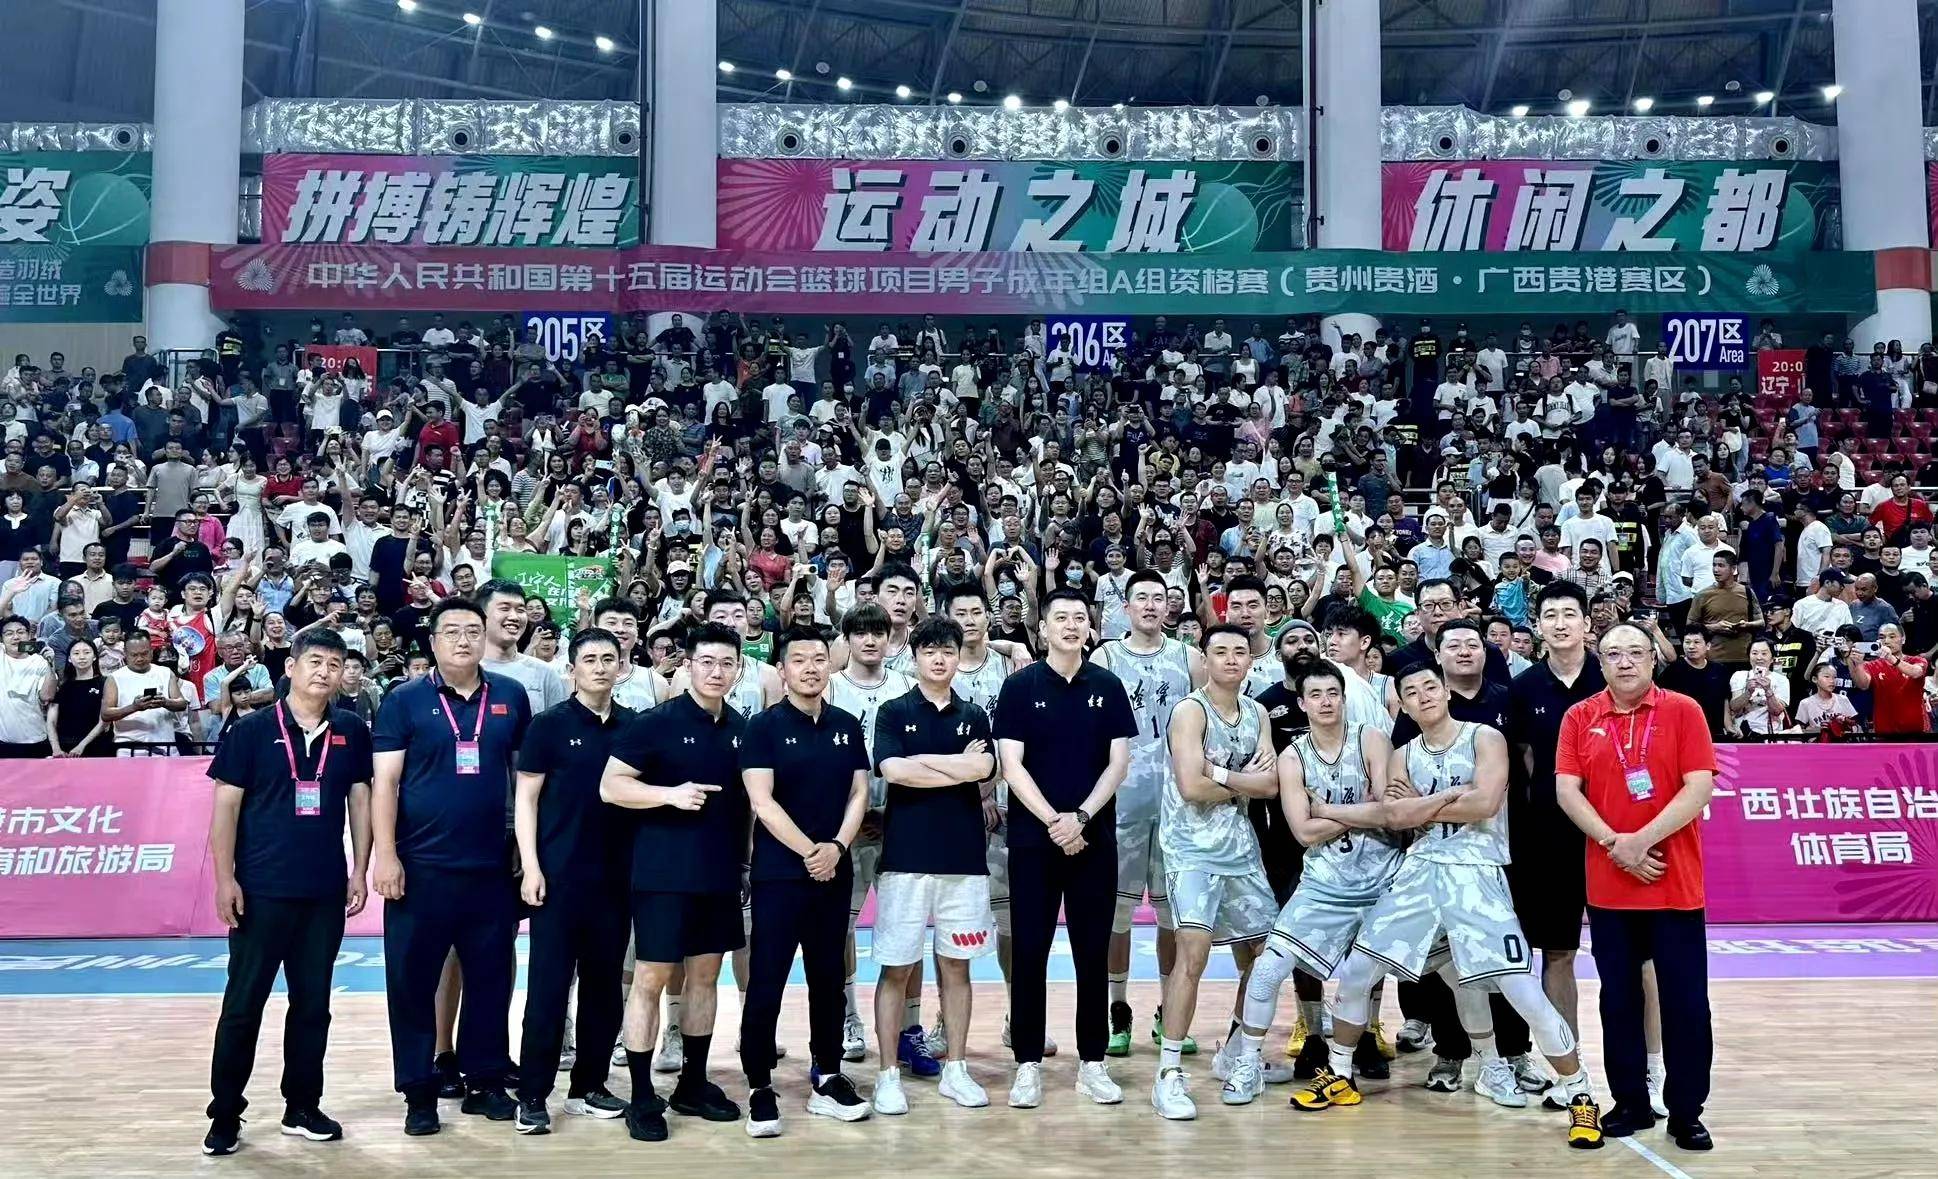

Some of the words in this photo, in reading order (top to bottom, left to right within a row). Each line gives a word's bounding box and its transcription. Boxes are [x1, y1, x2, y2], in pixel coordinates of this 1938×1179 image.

[281, 169, 630, 246] 拼搏铸辉煌
[811, 168, 1197, 253] 运动之城
[1408, 168, 1788, 252] 休闲之都
[1719, 346, 1744, 363] Area
[0, 805, 122, 835] 市文化
[1790, 831, 1914, 866] 体育局
